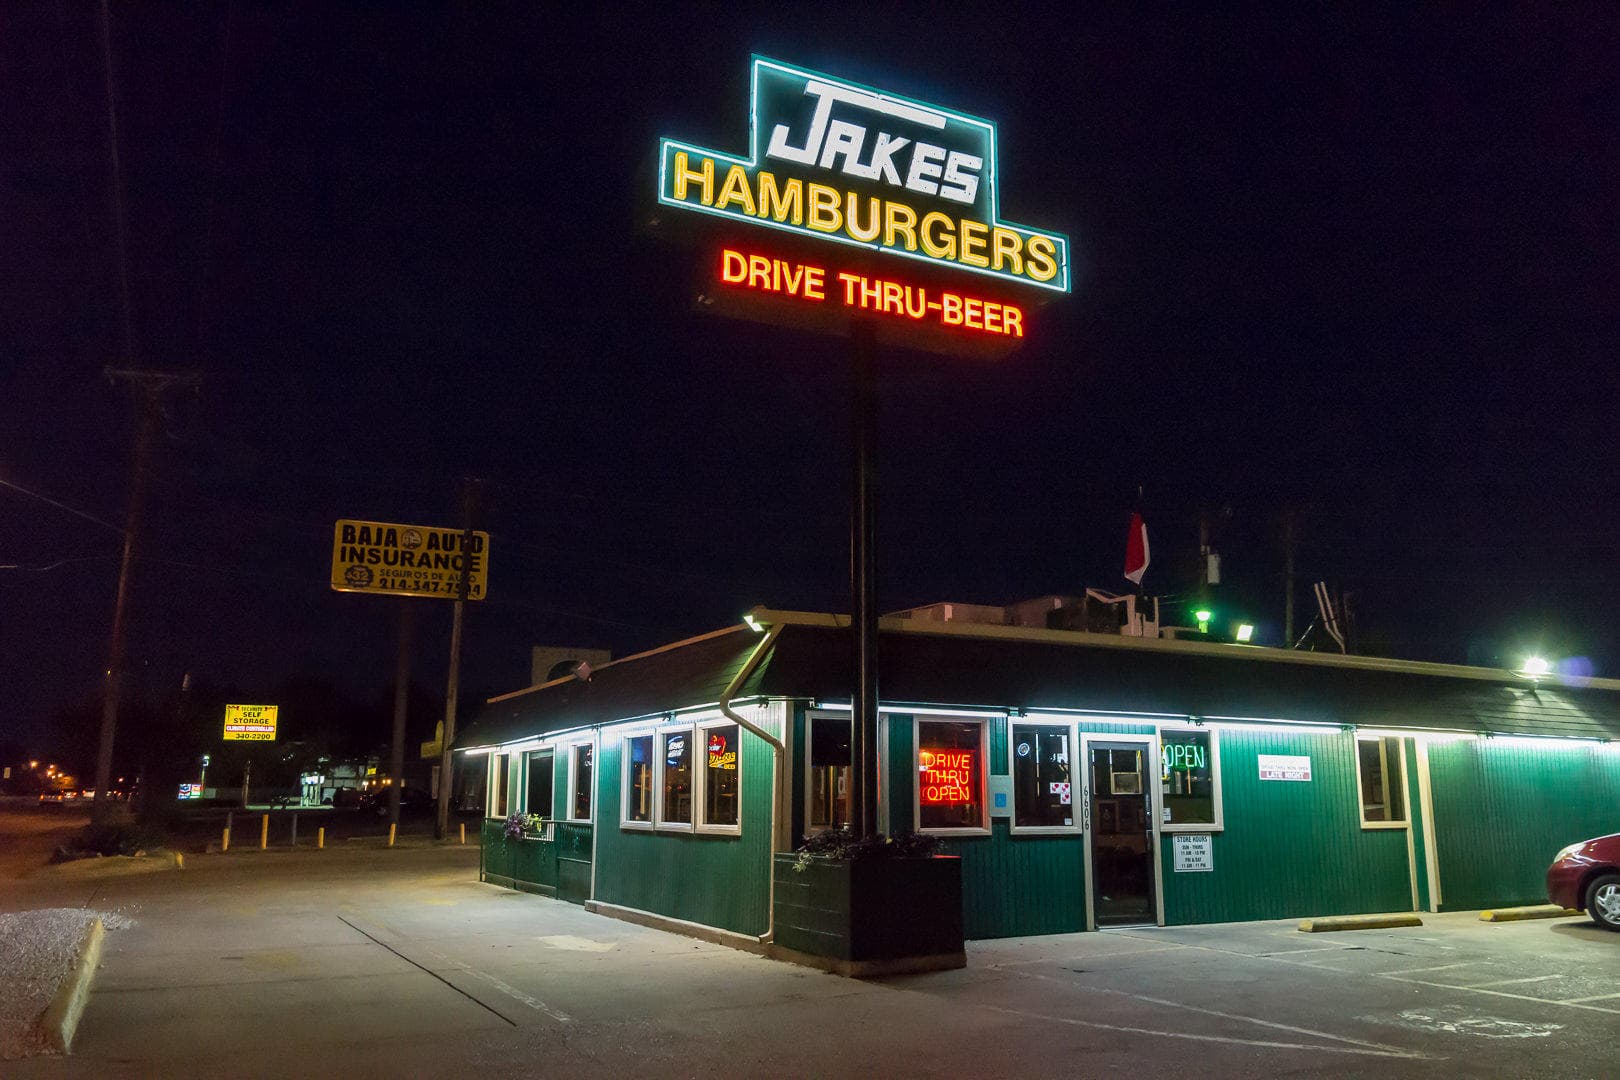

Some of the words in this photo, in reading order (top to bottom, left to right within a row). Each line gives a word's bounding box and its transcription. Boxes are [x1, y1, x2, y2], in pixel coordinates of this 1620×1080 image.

[766, 79, 983, 205] JAKES
[673, 150, 1058, 282] HAMBURGERS
[721, 249, 826, 300] DRIVE
[838, 273, 1025, 337] THRU-BEER
[341, 524, 399, 549] BAJA
[379, 568, 430, 581] SEGUROS
[431, 571, 444, 581] DE
[448, 573, 477, 584] AUO
[379, 578, 481, 596] 214-347-74
[925, 753, 971, 769] DRIVE
[1163, 744, 1205, 769] OPEN
[927, 769, 969, 785] THRU
[927, 786, 970, 801] OPEN
